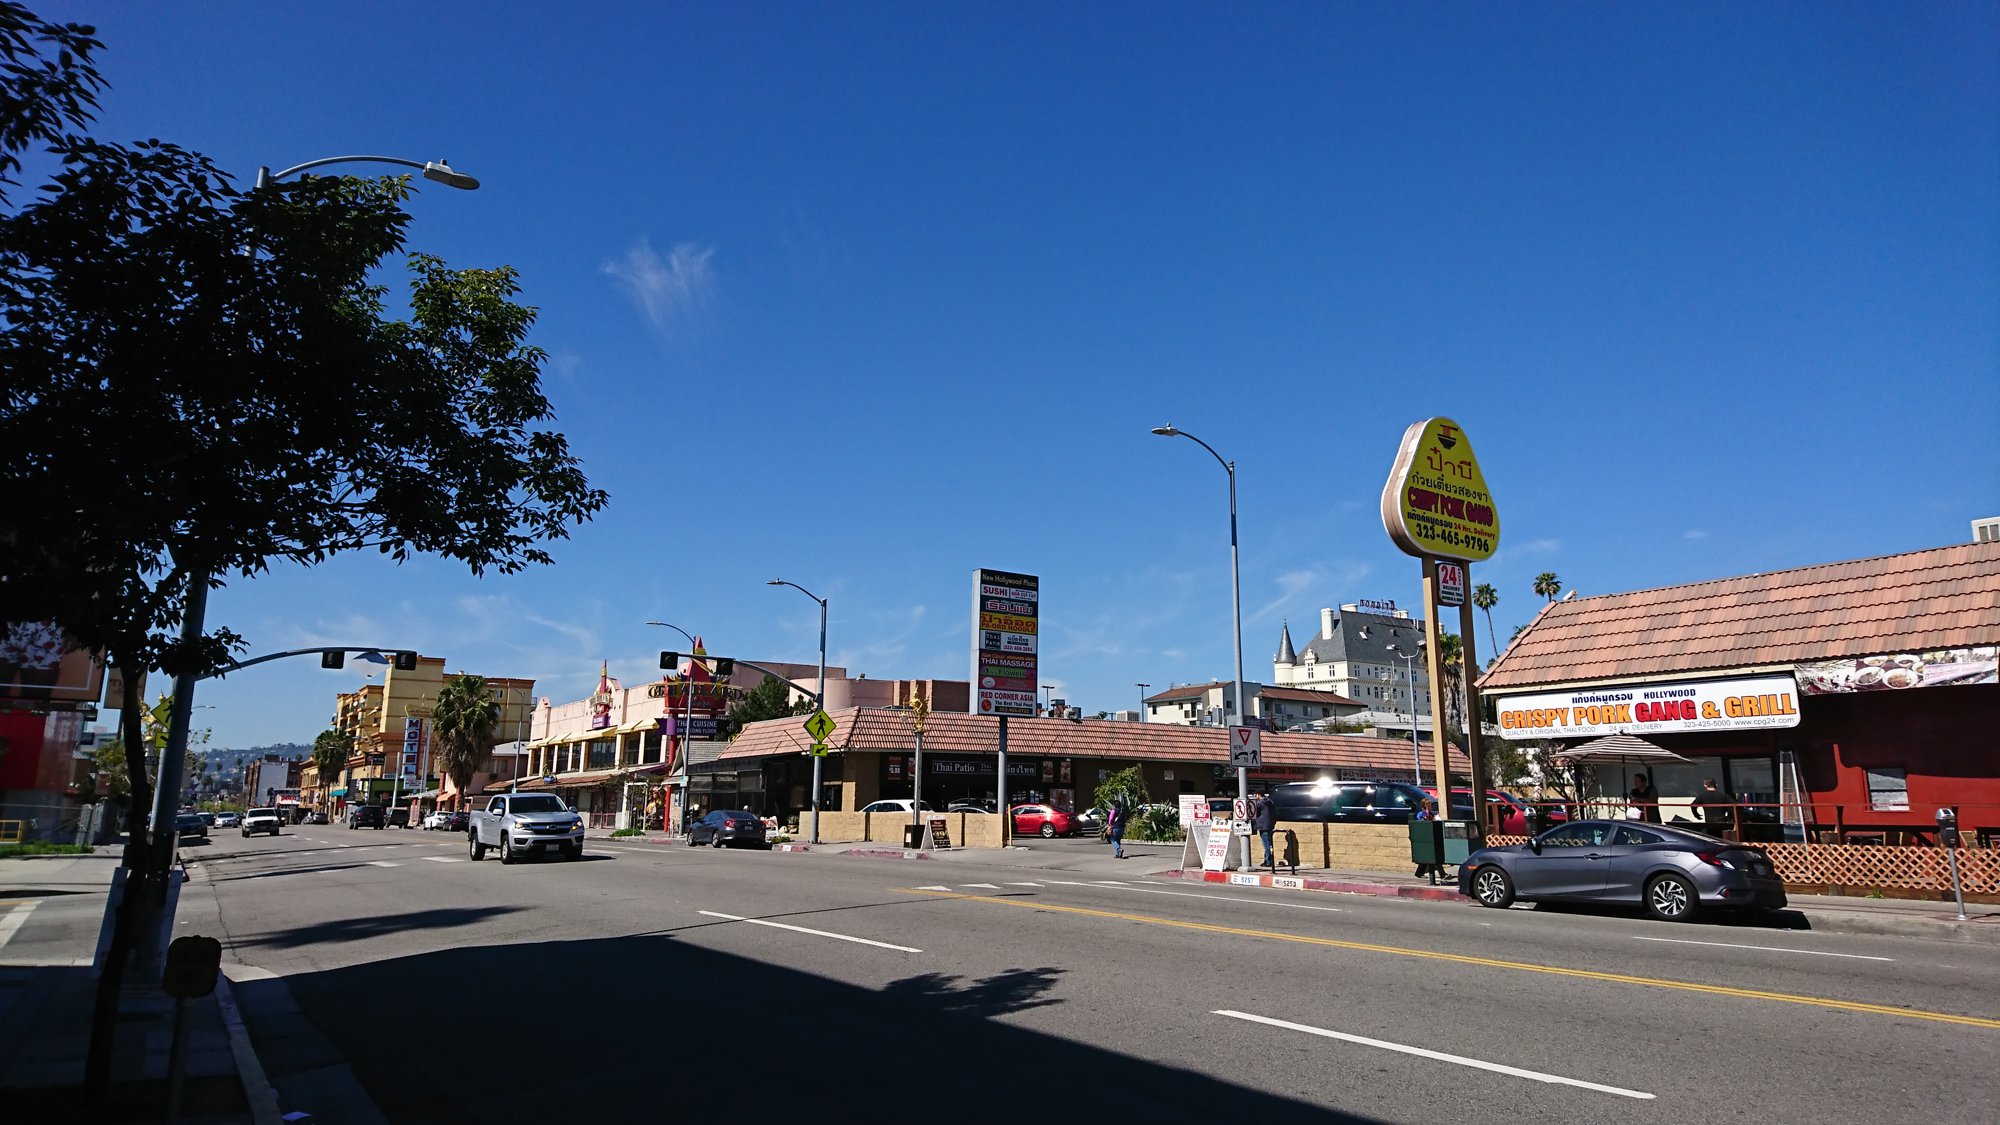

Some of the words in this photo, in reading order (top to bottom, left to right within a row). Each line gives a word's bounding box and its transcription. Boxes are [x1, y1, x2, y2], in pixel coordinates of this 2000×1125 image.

[1440, 494, 1466, 520] PORK
[1416, 522, 1490, 553] 323-465-9796
[1441, 565, 1458, 586] 24
[983, 586, 1008, 597] SUSHI
[981, 621, 1007, 630] PA-ORD
[1008, 625, 1037, 633] NOODLE
[1000, 660, 1036, 668] MASSAGE
[1020, 694, 1034, 702] ASIA
[1643, 688, 1697, 700] HOLLYWOOD
[1500, 706, 1570, 730] CRISPY
[1573, 703, 1633, 726] PORK
[1635, 699, 1697, 723] GANG
[1701, 701, 1721, 719] &
[1724, 693, 1797, 718] GRILL
[693, 720, 718, 728] CUISINE
[1632, 723, 1663, 731] DELIVERY
[1683, 719, 1731, 729] 323-425-5000
[1505, 729, 1529, 737] QUALITY
[404, 719, 420, 775] MOTEL
[935, 761, 953, 772] Thai
[954, 762, 975, 773] Patio
